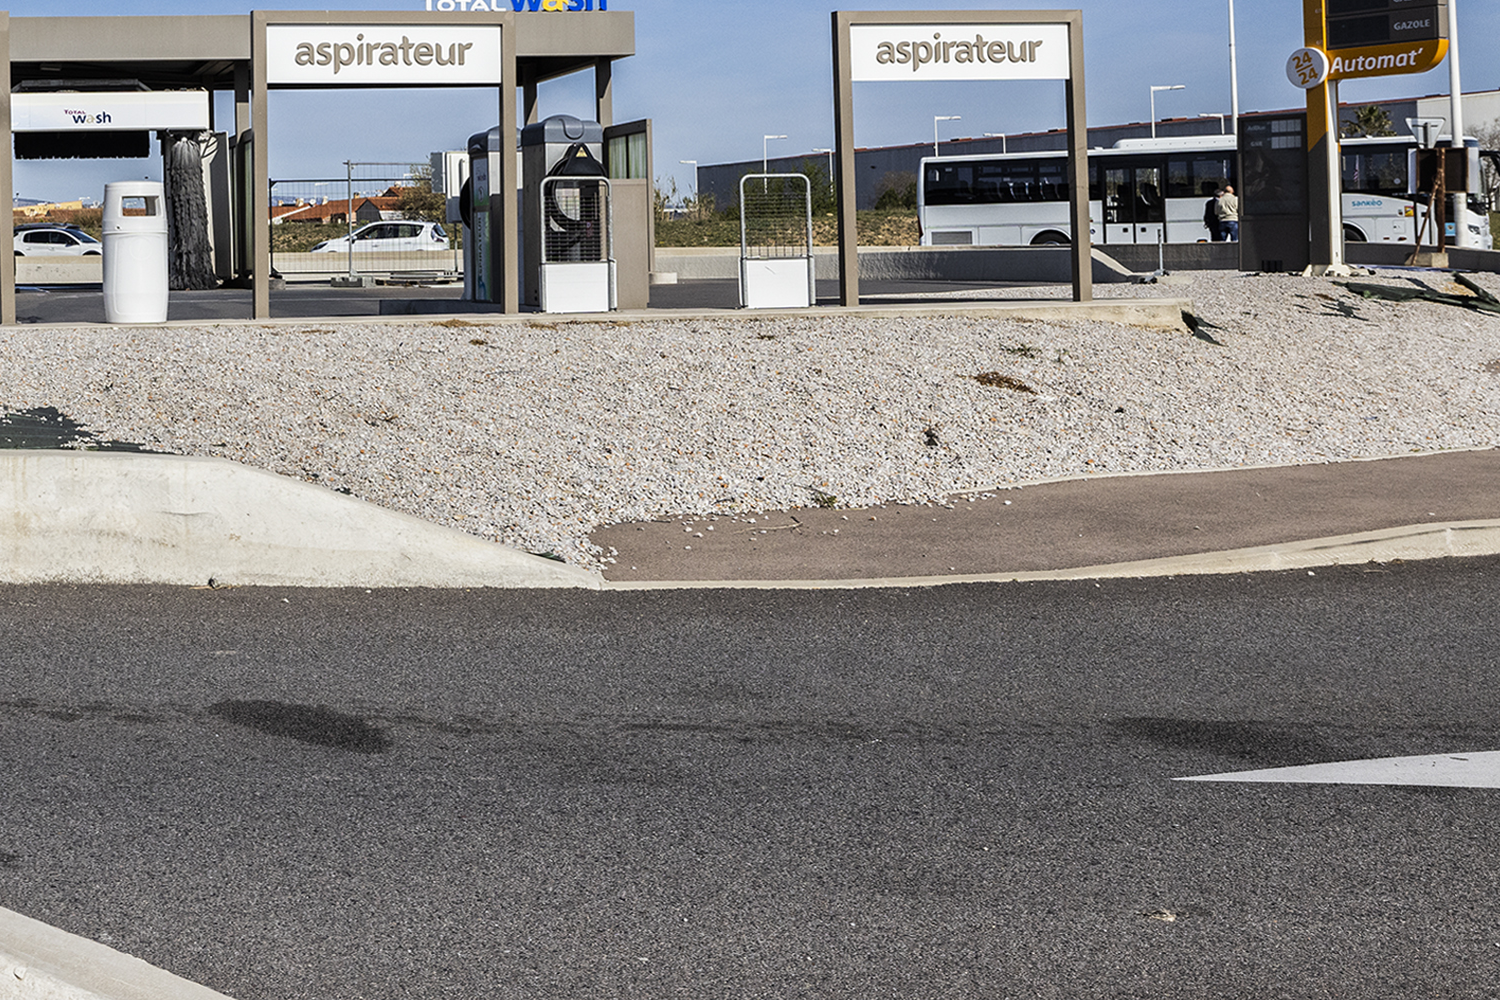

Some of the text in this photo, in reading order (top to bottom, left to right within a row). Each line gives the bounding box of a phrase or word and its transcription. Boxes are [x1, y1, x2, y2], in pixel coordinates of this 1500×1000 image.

[1393, 18, 1431, 31] GAZOLE
[295, 33, 474, 74] aspirateur
[875, 31, 1044, 72] aspirateur
[1292, 51, 1313, 69] 24
[1298, 67, 1319, 86] 24
[72, 111, 112, 124] wash
